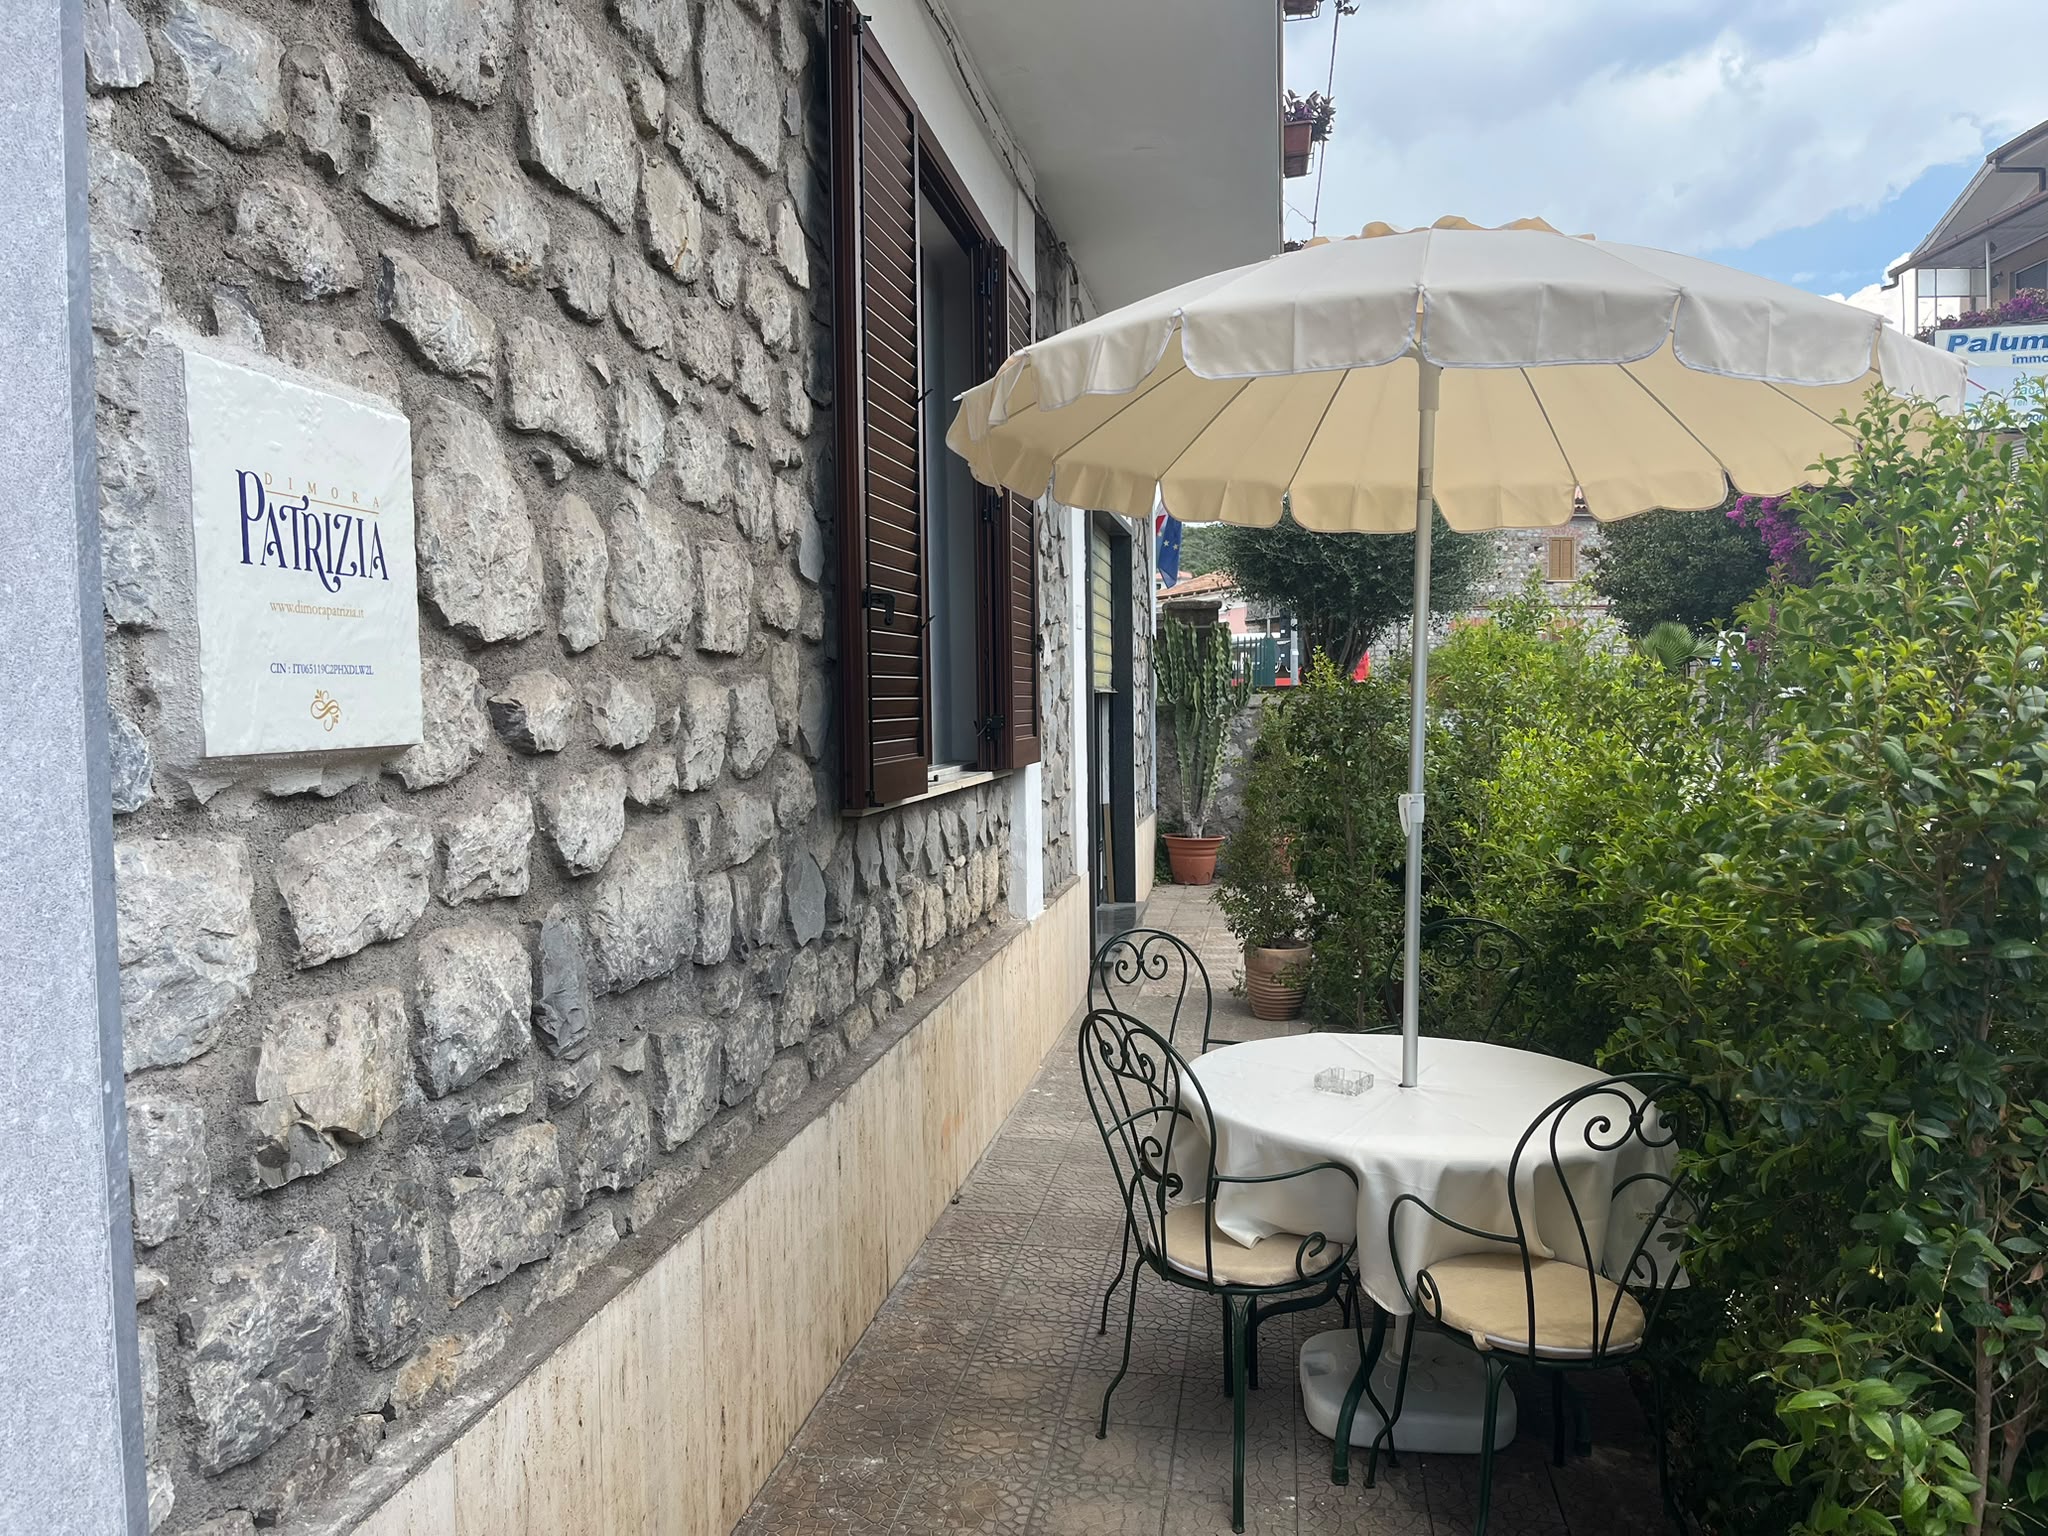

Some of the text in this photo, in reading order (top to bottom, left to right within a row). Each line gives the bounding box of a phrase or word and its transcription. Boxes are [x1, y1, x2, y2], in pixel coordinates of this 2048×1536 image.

[264, 471, 380, 508] DIMORA
[235, 469, 390, 594] PATRIZIA
[269, 600, 365, 621] www.dimorapatrizia.it
[269, 662, 287, 674] CIN
